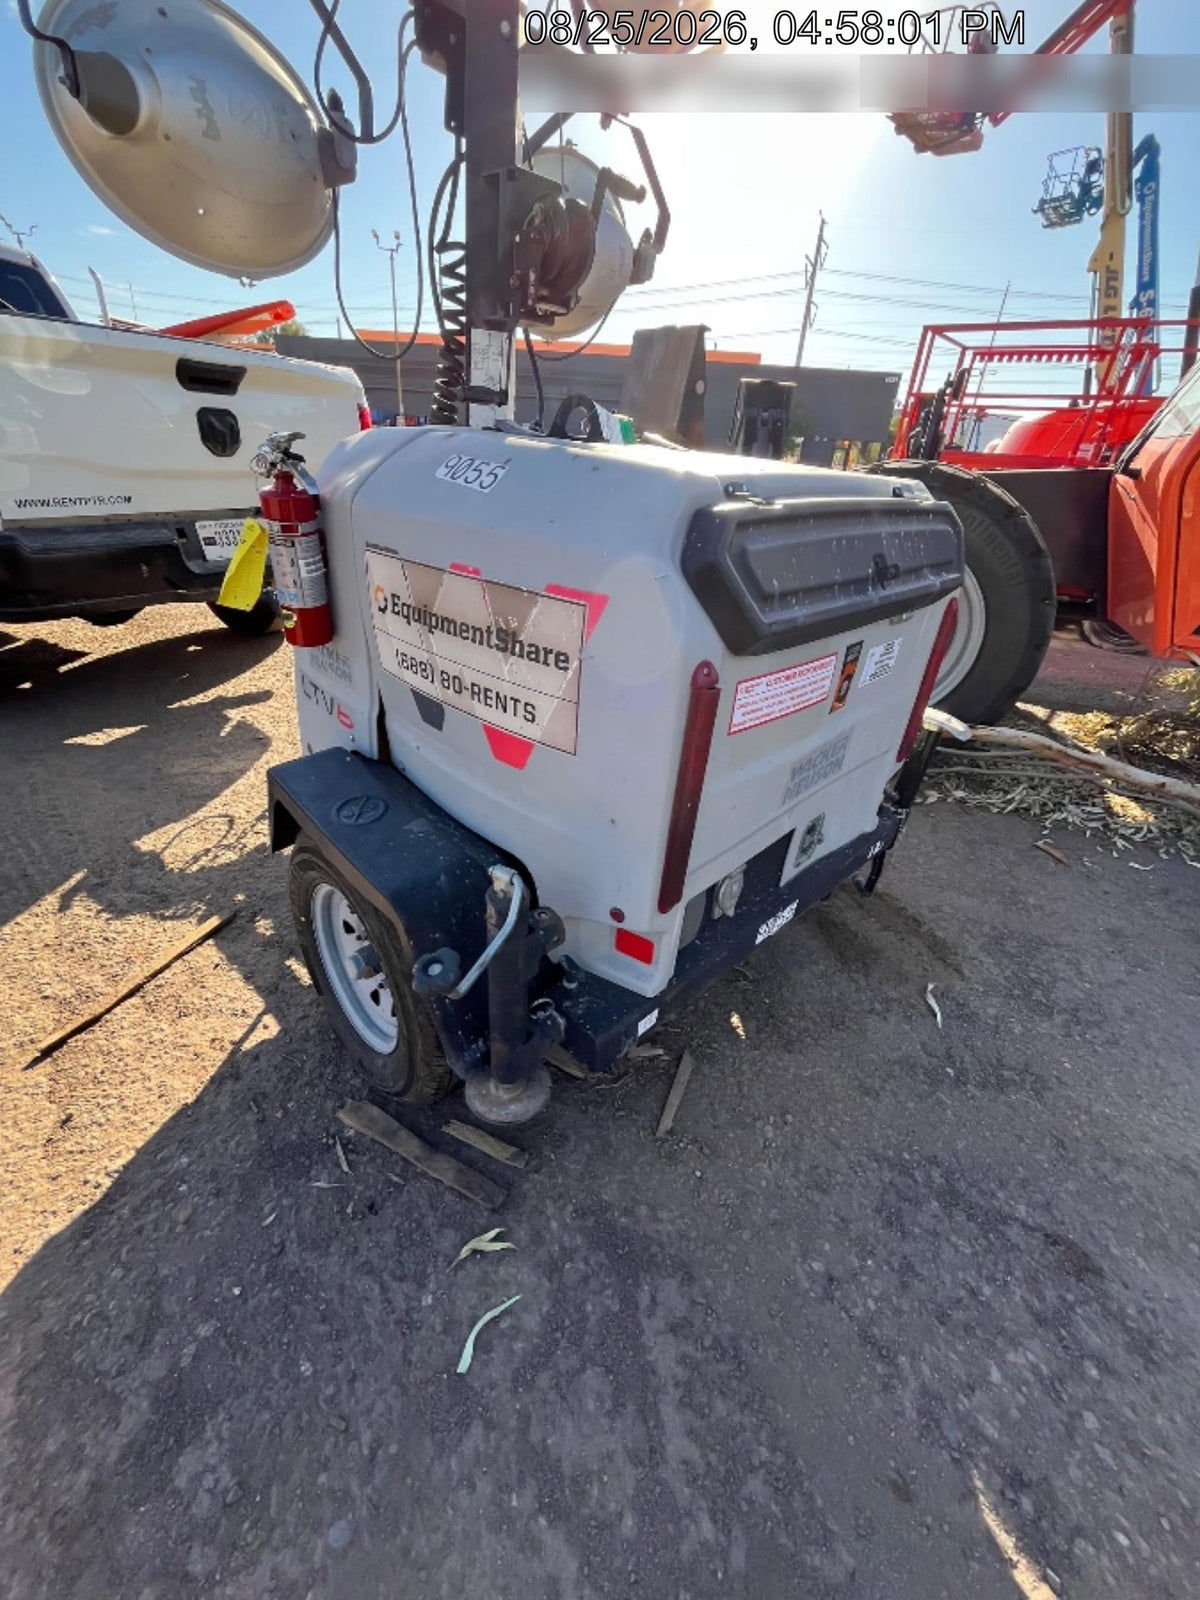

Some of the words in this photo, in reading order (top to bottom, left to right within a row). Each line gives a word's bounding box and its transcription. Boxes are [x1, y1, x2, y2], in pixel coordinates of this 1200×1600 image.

[1104, 265, 1120, 298] JLG
[444, 455, 506, 489] 9055
[391, 593, 570, 672] EquipmentShare
[440, 669, 536, 724] 80-RENTS
